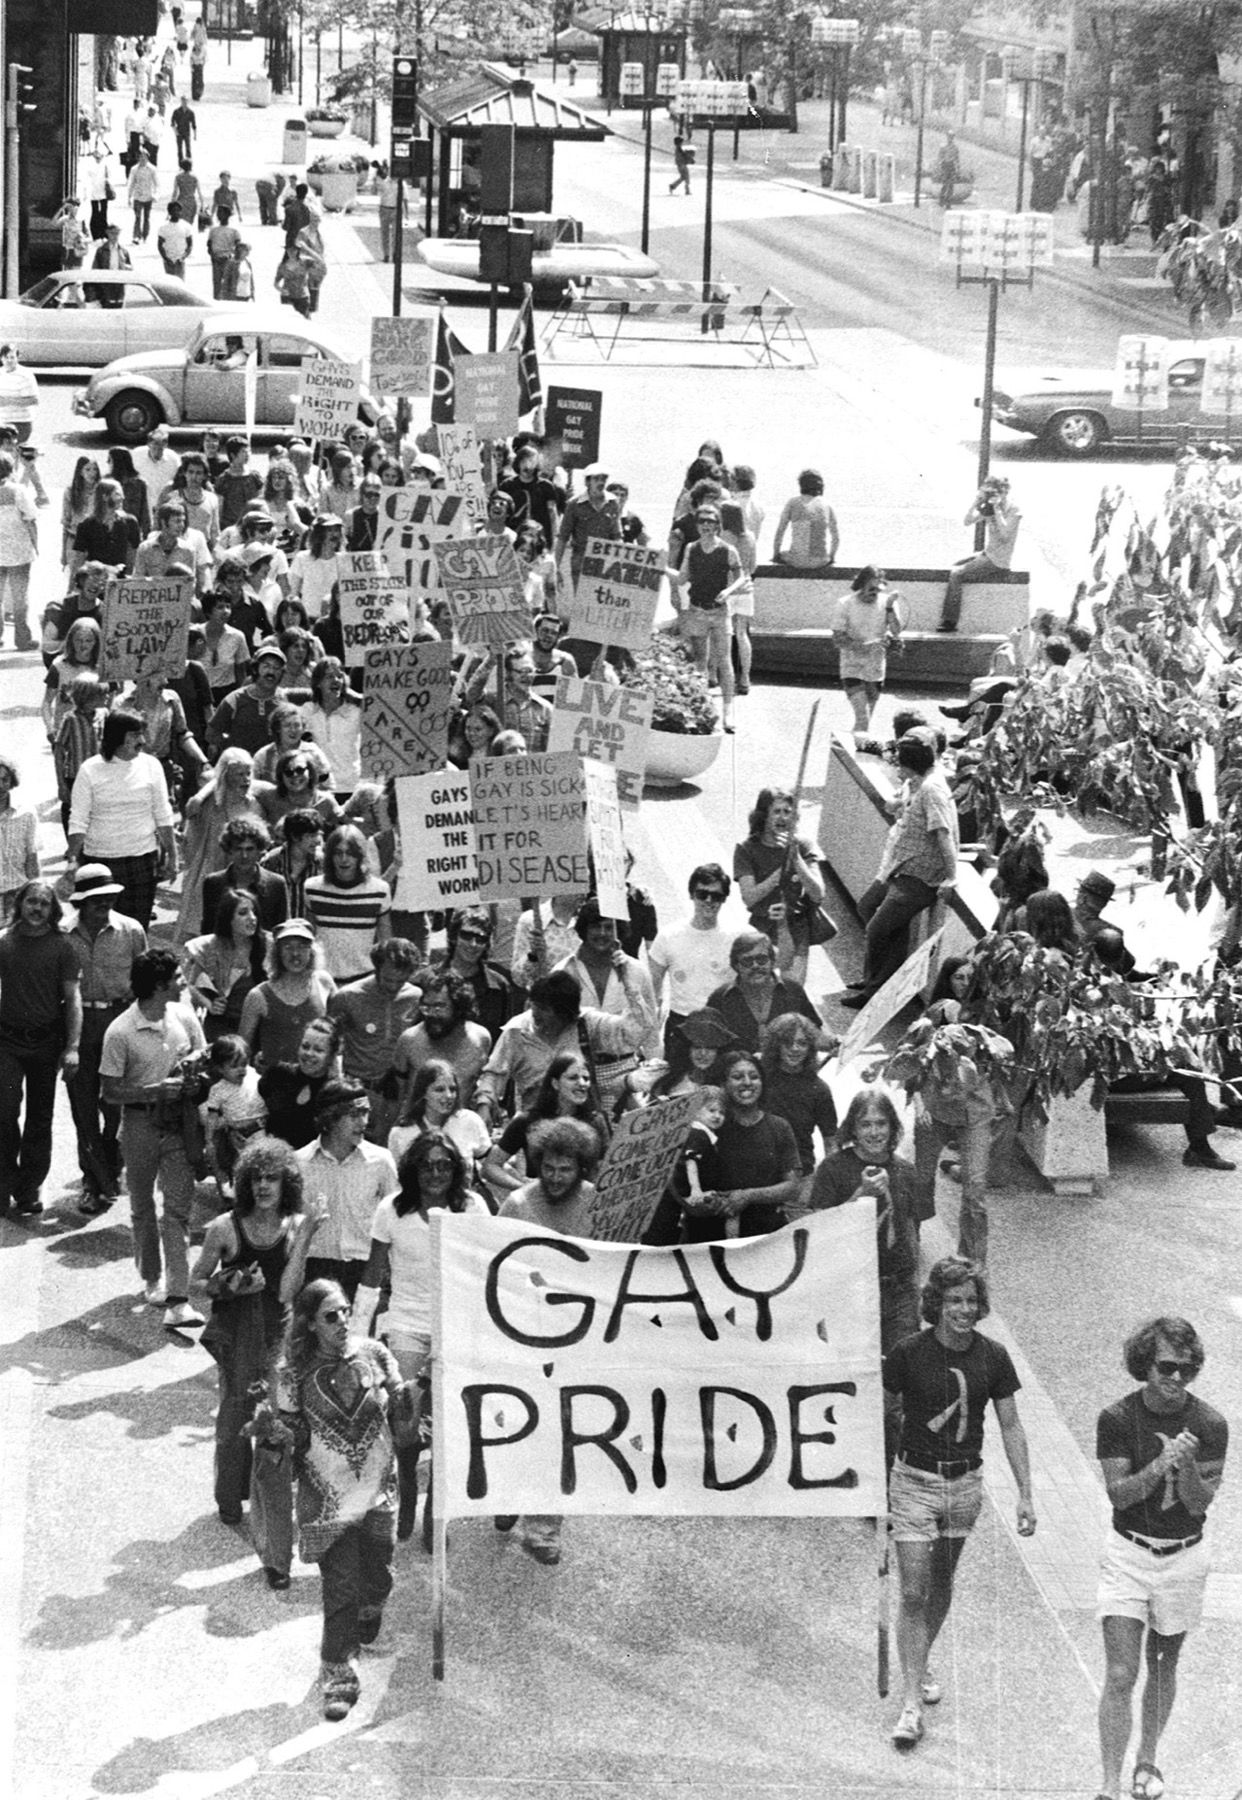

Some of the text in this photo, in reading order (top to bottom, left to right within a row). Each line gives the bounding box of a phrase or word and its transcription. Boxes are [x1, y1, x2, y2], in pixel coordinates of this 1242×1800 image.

[311, 360, 350, 376] GAYS
[465, 365, 506, 378] NATIONAL
[306, 373, 354, 390] DEMAND
[557, 398, 593, 411] NATIONAL
[315, 409, 333, 420] TO
[565, 414, 582, 426] GAY
[300, 418, 348, 438] WORK
[563, 428, 584, 439] PRIDE
[562, 443, 582, 454] WEEK
[385, 491, 463, 526] GAY
[592, 541, 660, 567] BETTER
[341, 577, 368, 592] THE
[356, 593, 395, 607] OUT OF
[594, 586, 630, 608] than
[136, 607, 164, 620] THE
[363, 608, 386, 620] OUR
[367, 647, 419, 668] GAYS
[365, 670, 414, 689] MAKE
[555, 678, 647, 726] LIVE
[574, 716, 625, 741] AND
[573, 736, 624, 762] LET
[476, 758, 557, 779] IF BEING
[431, 786, 469, 805] GAYS
[474, 781, 513, 800] GAY
[521, 781, 535, 798] IS
[540, 777, 582, 797] SICK
[425, 810, 474, 829] DEMAN
[474, 805, 530, 824] LET'S
[538, 802, 583, 821] HEAR
[443, 831, 468, 847] THE
[479, 831, 543, 851] IT FOR
[427, 855, 468, 873] RIGHT
[478, 854, 588, 886] DISEASE
[597, 1158, 647, 1192] COME
[485, 1228, 809, 1348] GAY
[461, 1381, 859, 1500] PRIDE
